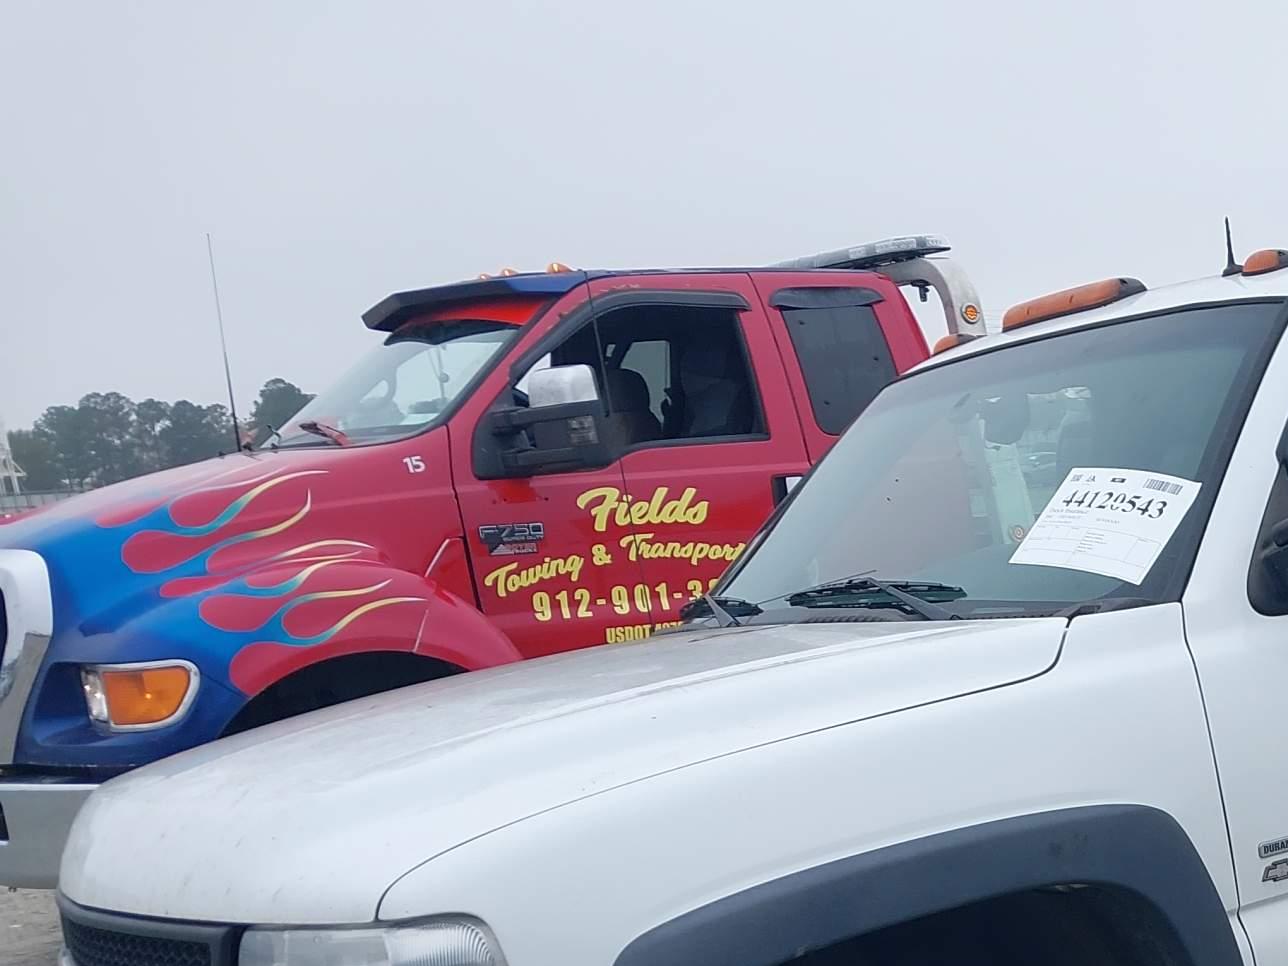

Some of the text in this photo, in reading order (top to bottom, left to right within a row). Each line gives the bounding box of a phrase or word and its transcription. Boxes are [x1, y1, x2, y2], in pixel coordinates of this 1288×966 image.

[402, 455, 426, 474] 15
[576, 487, 710, 532] Fields
[1061, 489, 1168, 519] 44120543
[484, 533, 747, 598] Towing & Transport
[605, 624, 652, 644] USDOT
